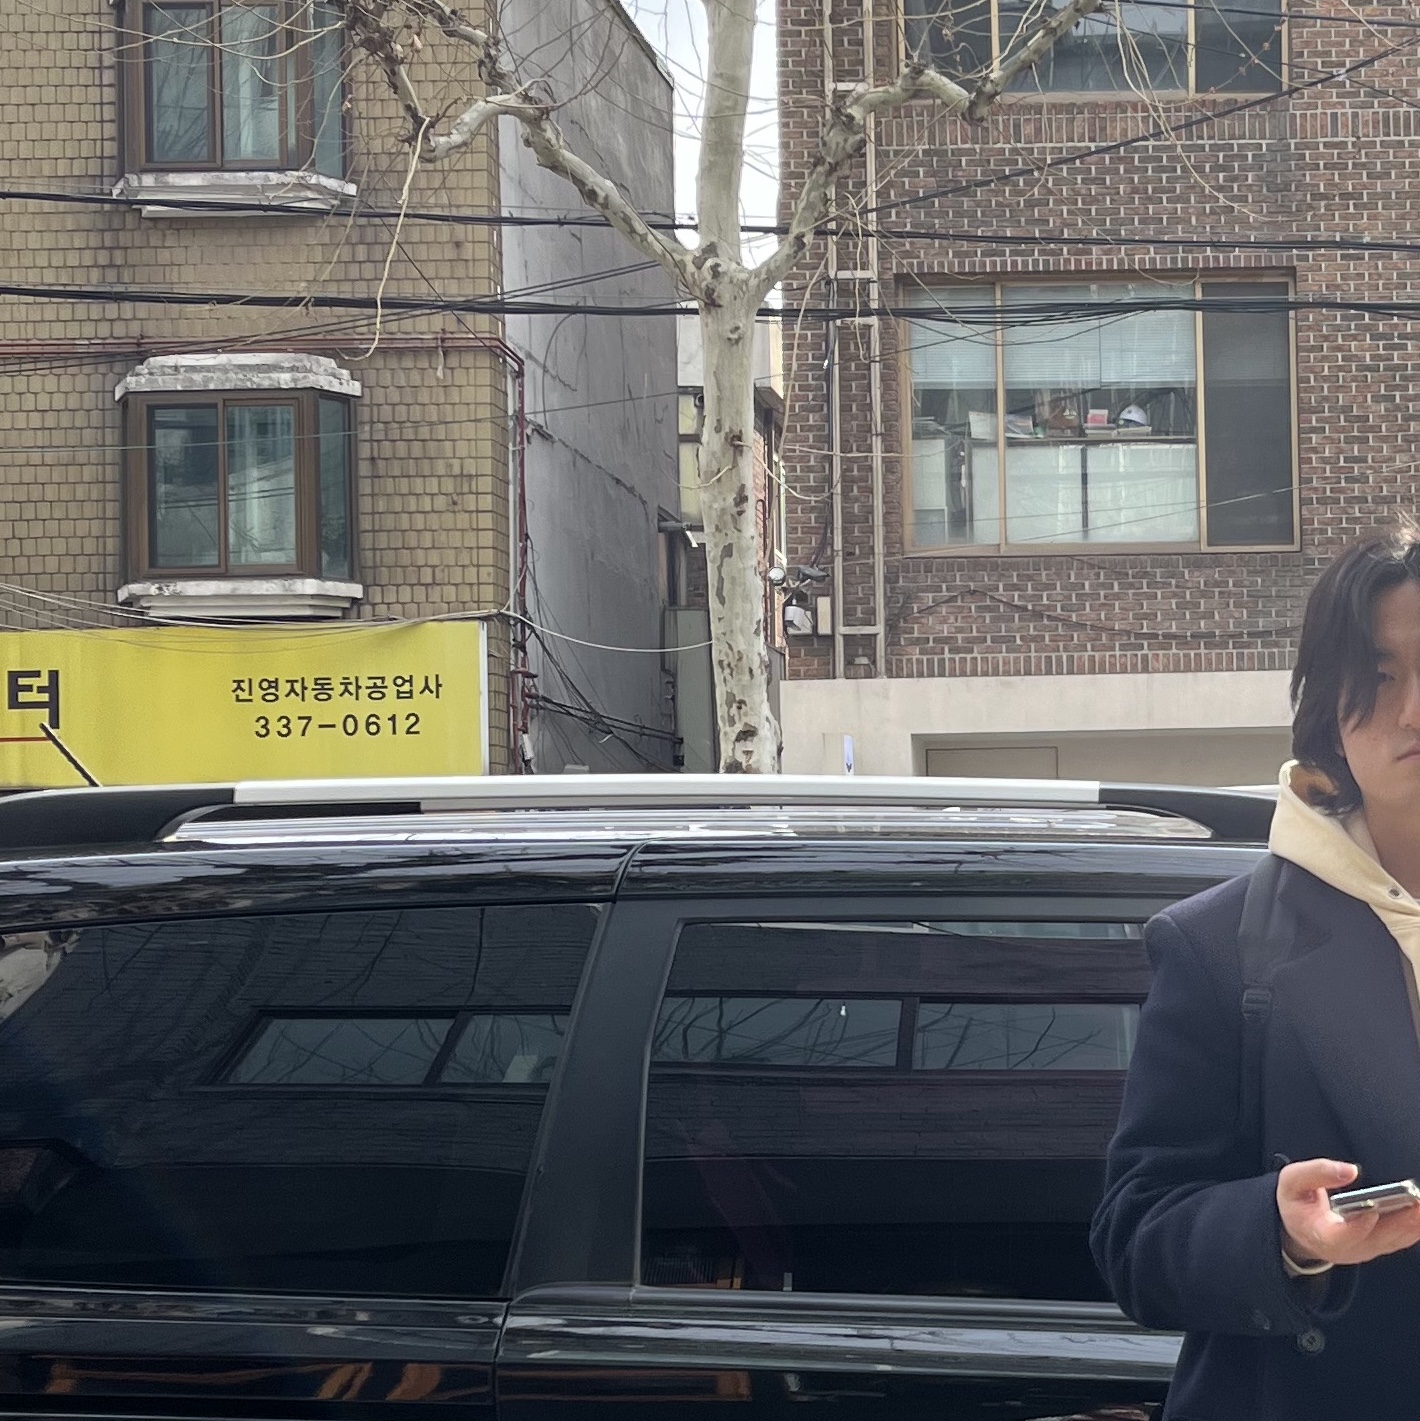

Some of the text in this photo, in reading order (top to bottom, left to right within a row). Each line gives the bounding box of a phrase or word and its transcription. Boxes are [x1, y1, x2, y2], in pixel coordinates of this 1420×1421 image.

[8, 670, 60, 730] 터
[231, 674, 443, 703] 진영자동차공업사
[254, 713, 421, 738] 337-0612
